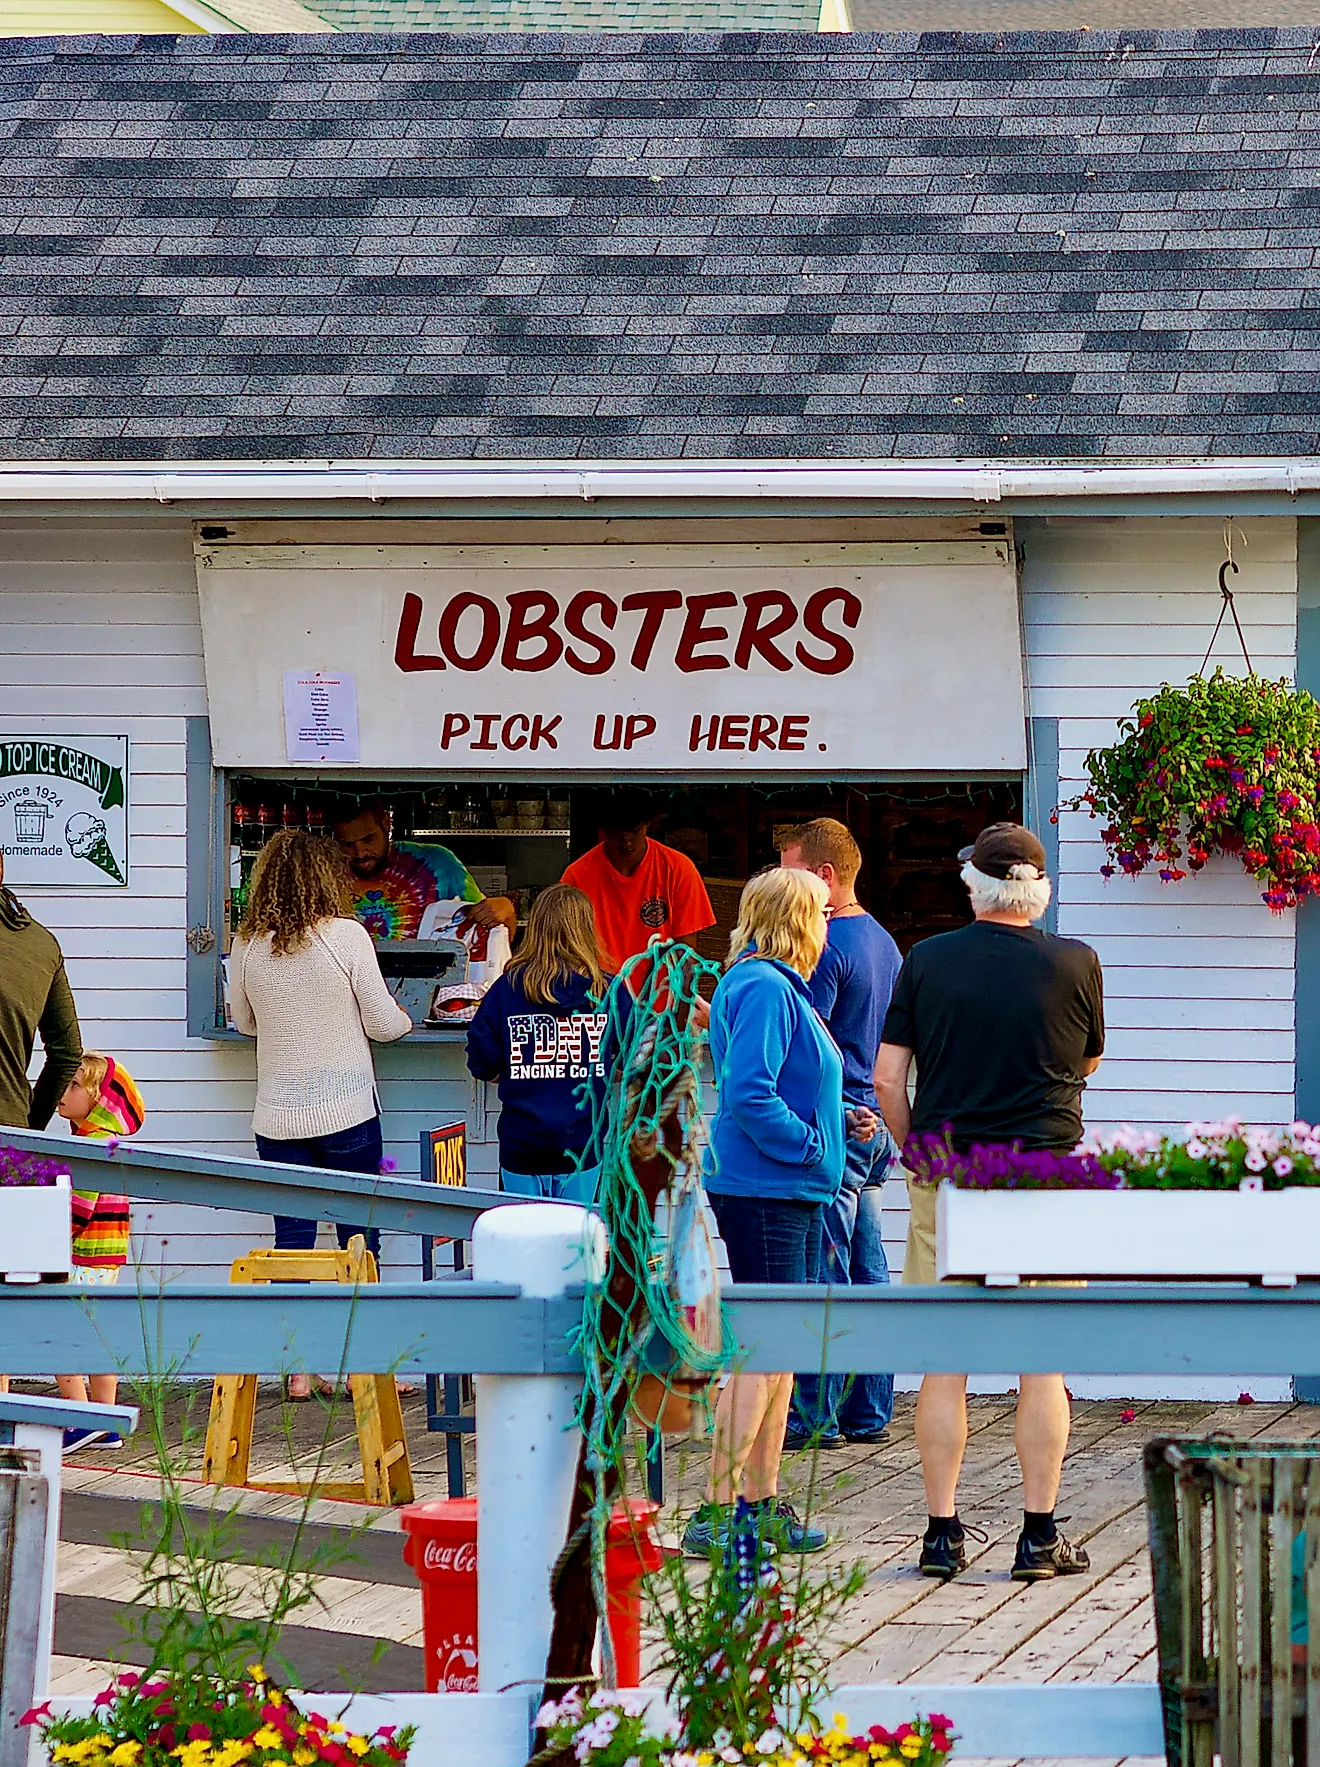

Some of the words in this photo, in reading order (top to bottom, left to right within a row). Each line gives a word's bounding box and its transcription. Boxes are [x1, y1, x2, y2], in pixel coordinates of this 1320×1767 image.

[394, 586, 863, 676] LOBSTERS
[439, 712, 563, 751] PICK
[592, 713, 658, 751] UP
[687, 713, 829, 752] HERE.
[5, 743, 33, 773] TOP
[35, 743, 56, 774] ICE
[58, 747, 102, 791] CREAM
[35, 785, 64, 808] 1924
[507, 1013, 608, 1065] FDNY
[509, 1064, 566, 1080] ENGINE
[595, 1063, 606, 1077] 5
[433, 1135, 464, 1187] TRAYS
[423, 1538, 478, 1573] Coca-Co
[436, 1632, 475, 1661] PLEA
